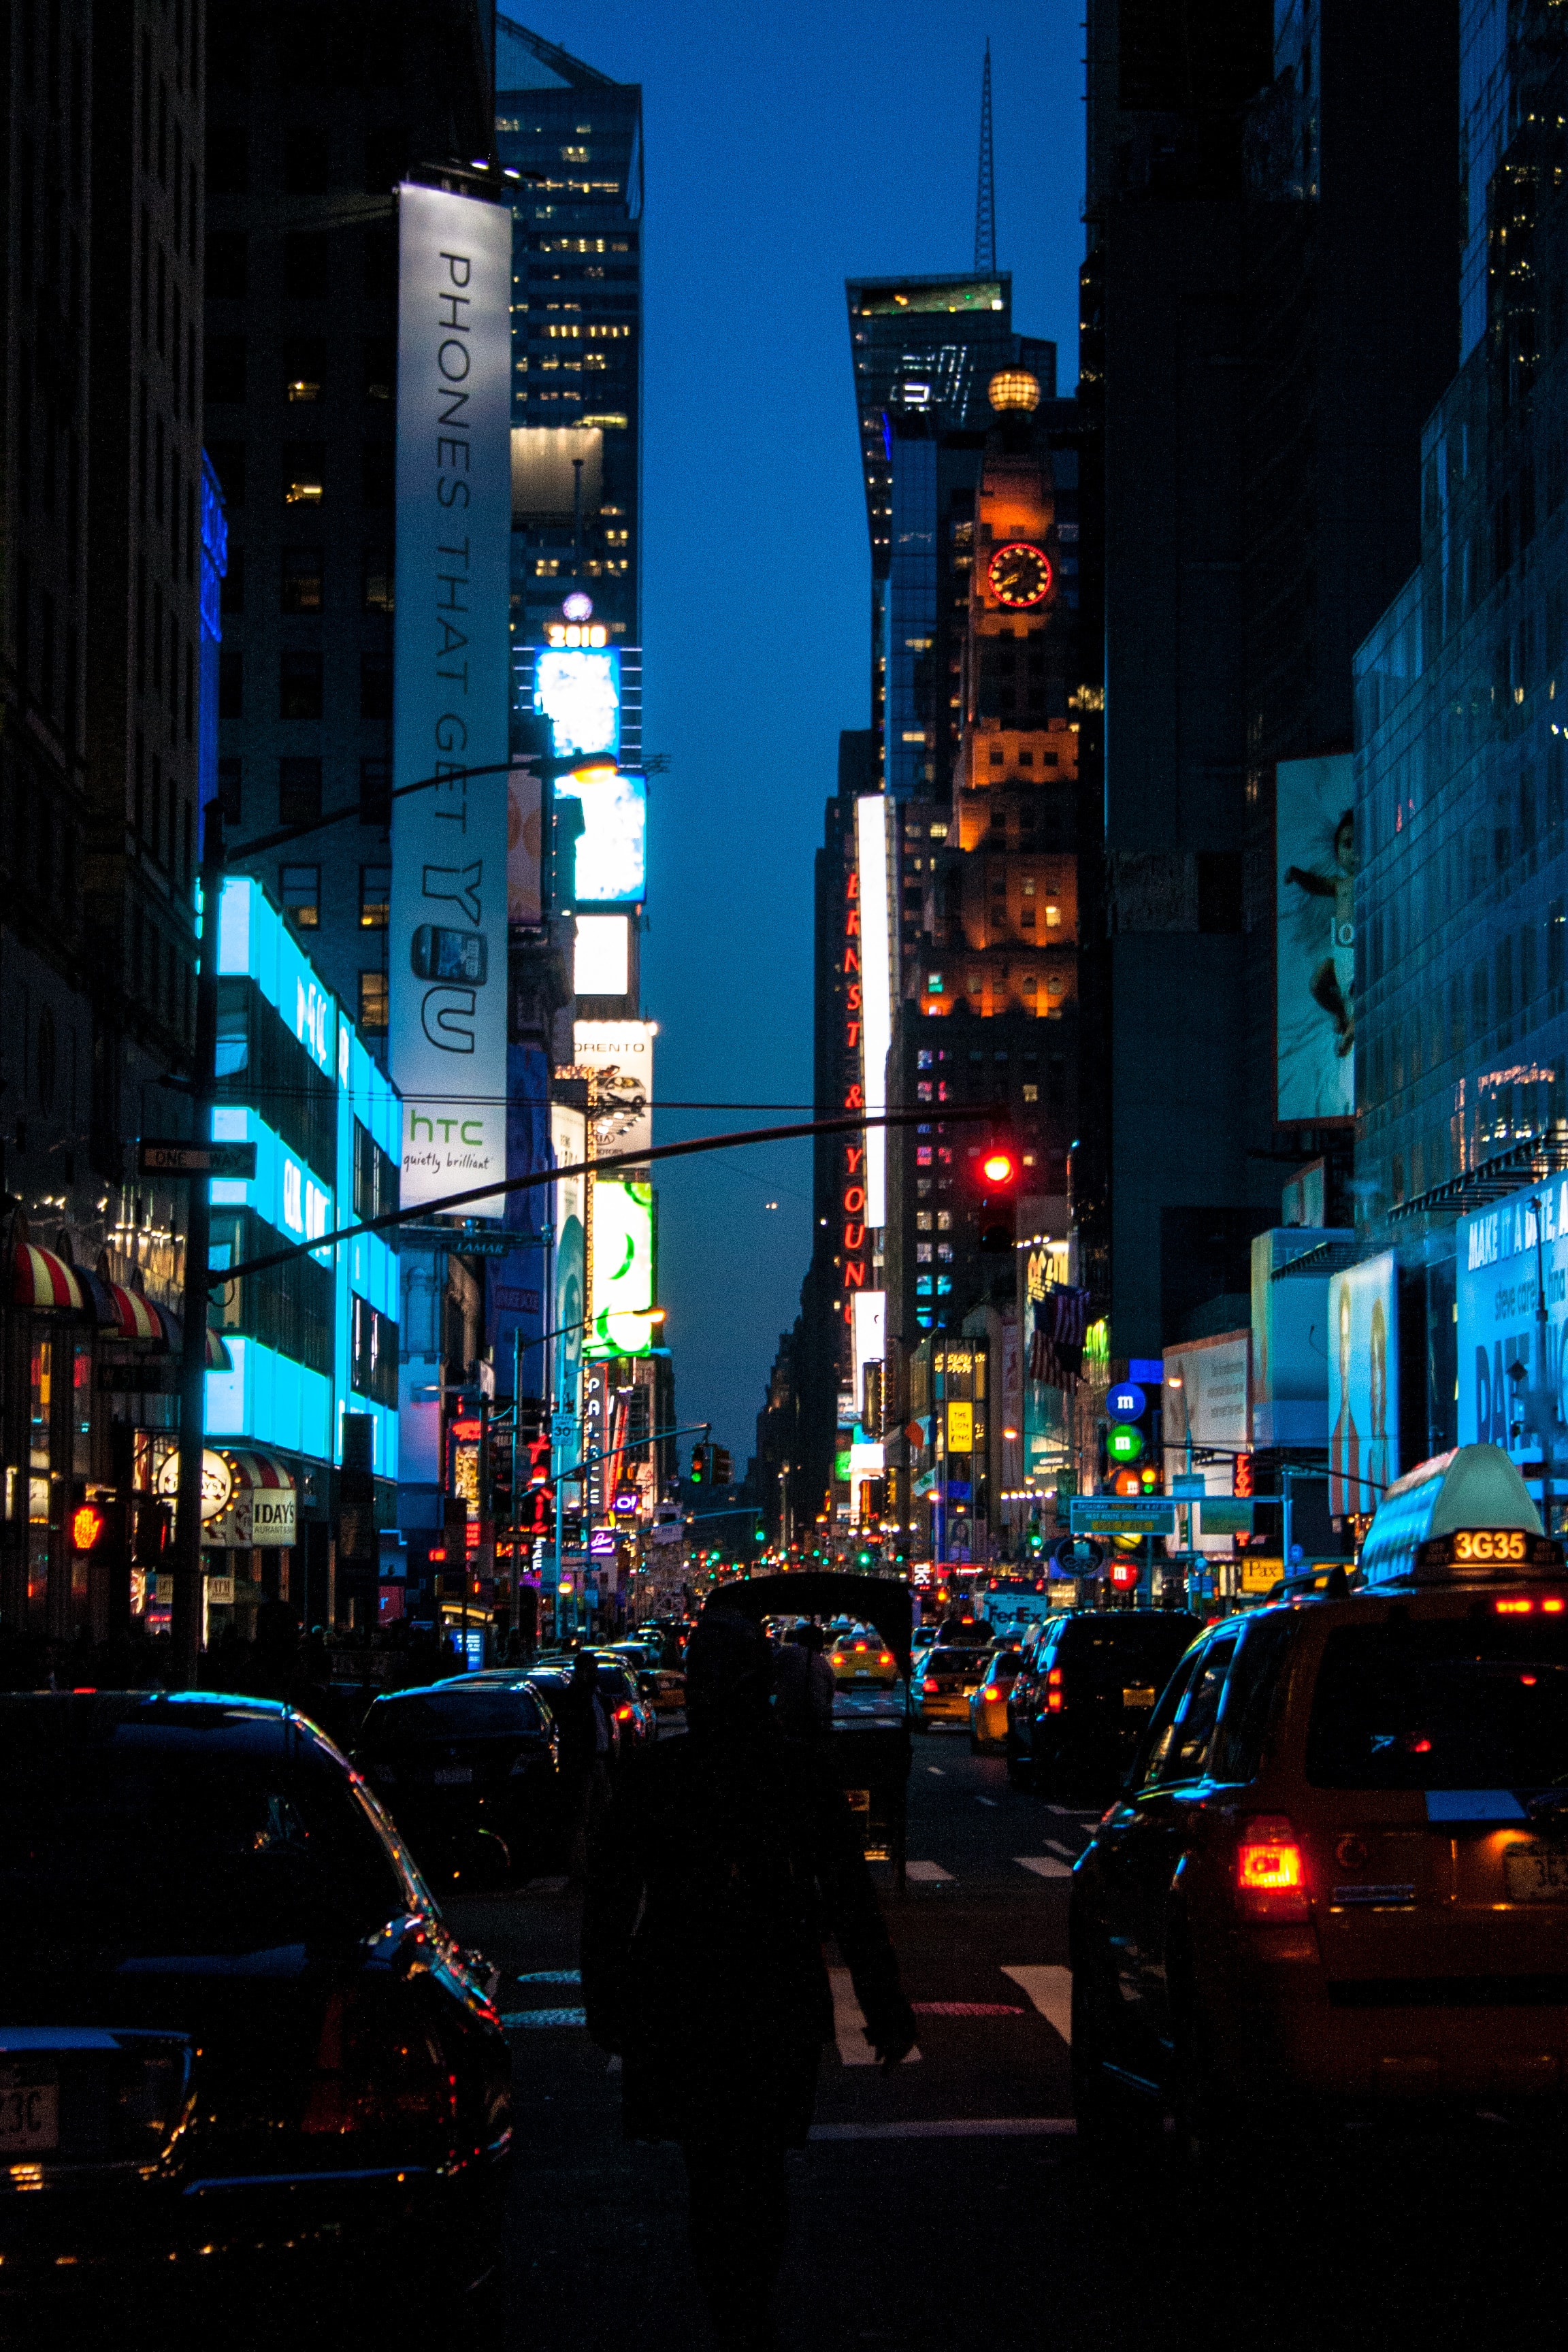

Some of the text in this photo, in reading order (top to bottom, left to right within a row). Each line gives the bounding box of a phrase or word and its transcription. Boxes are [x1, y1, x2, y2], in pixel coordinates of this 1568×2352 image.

[434, 252, 471, 835] PHONES THAT GET
[549, 624, 607, 648] 2010
[843, 872, 861, 1047] ERNST
[844, 1083, 864, 1109] &
[155, 1150, 242, 1168] ONE WAY
[403, 1152, 490, 1174] quietly brilliant
[455, 1241, 505, 1254] LAMAR
[554, 1426, 571, 1437] 30
[951, 1433, 970, 1443] KING
[1455, 1531, 1526, 1560] 3G35
[1247, 1561, 1278, 1578] Pax
